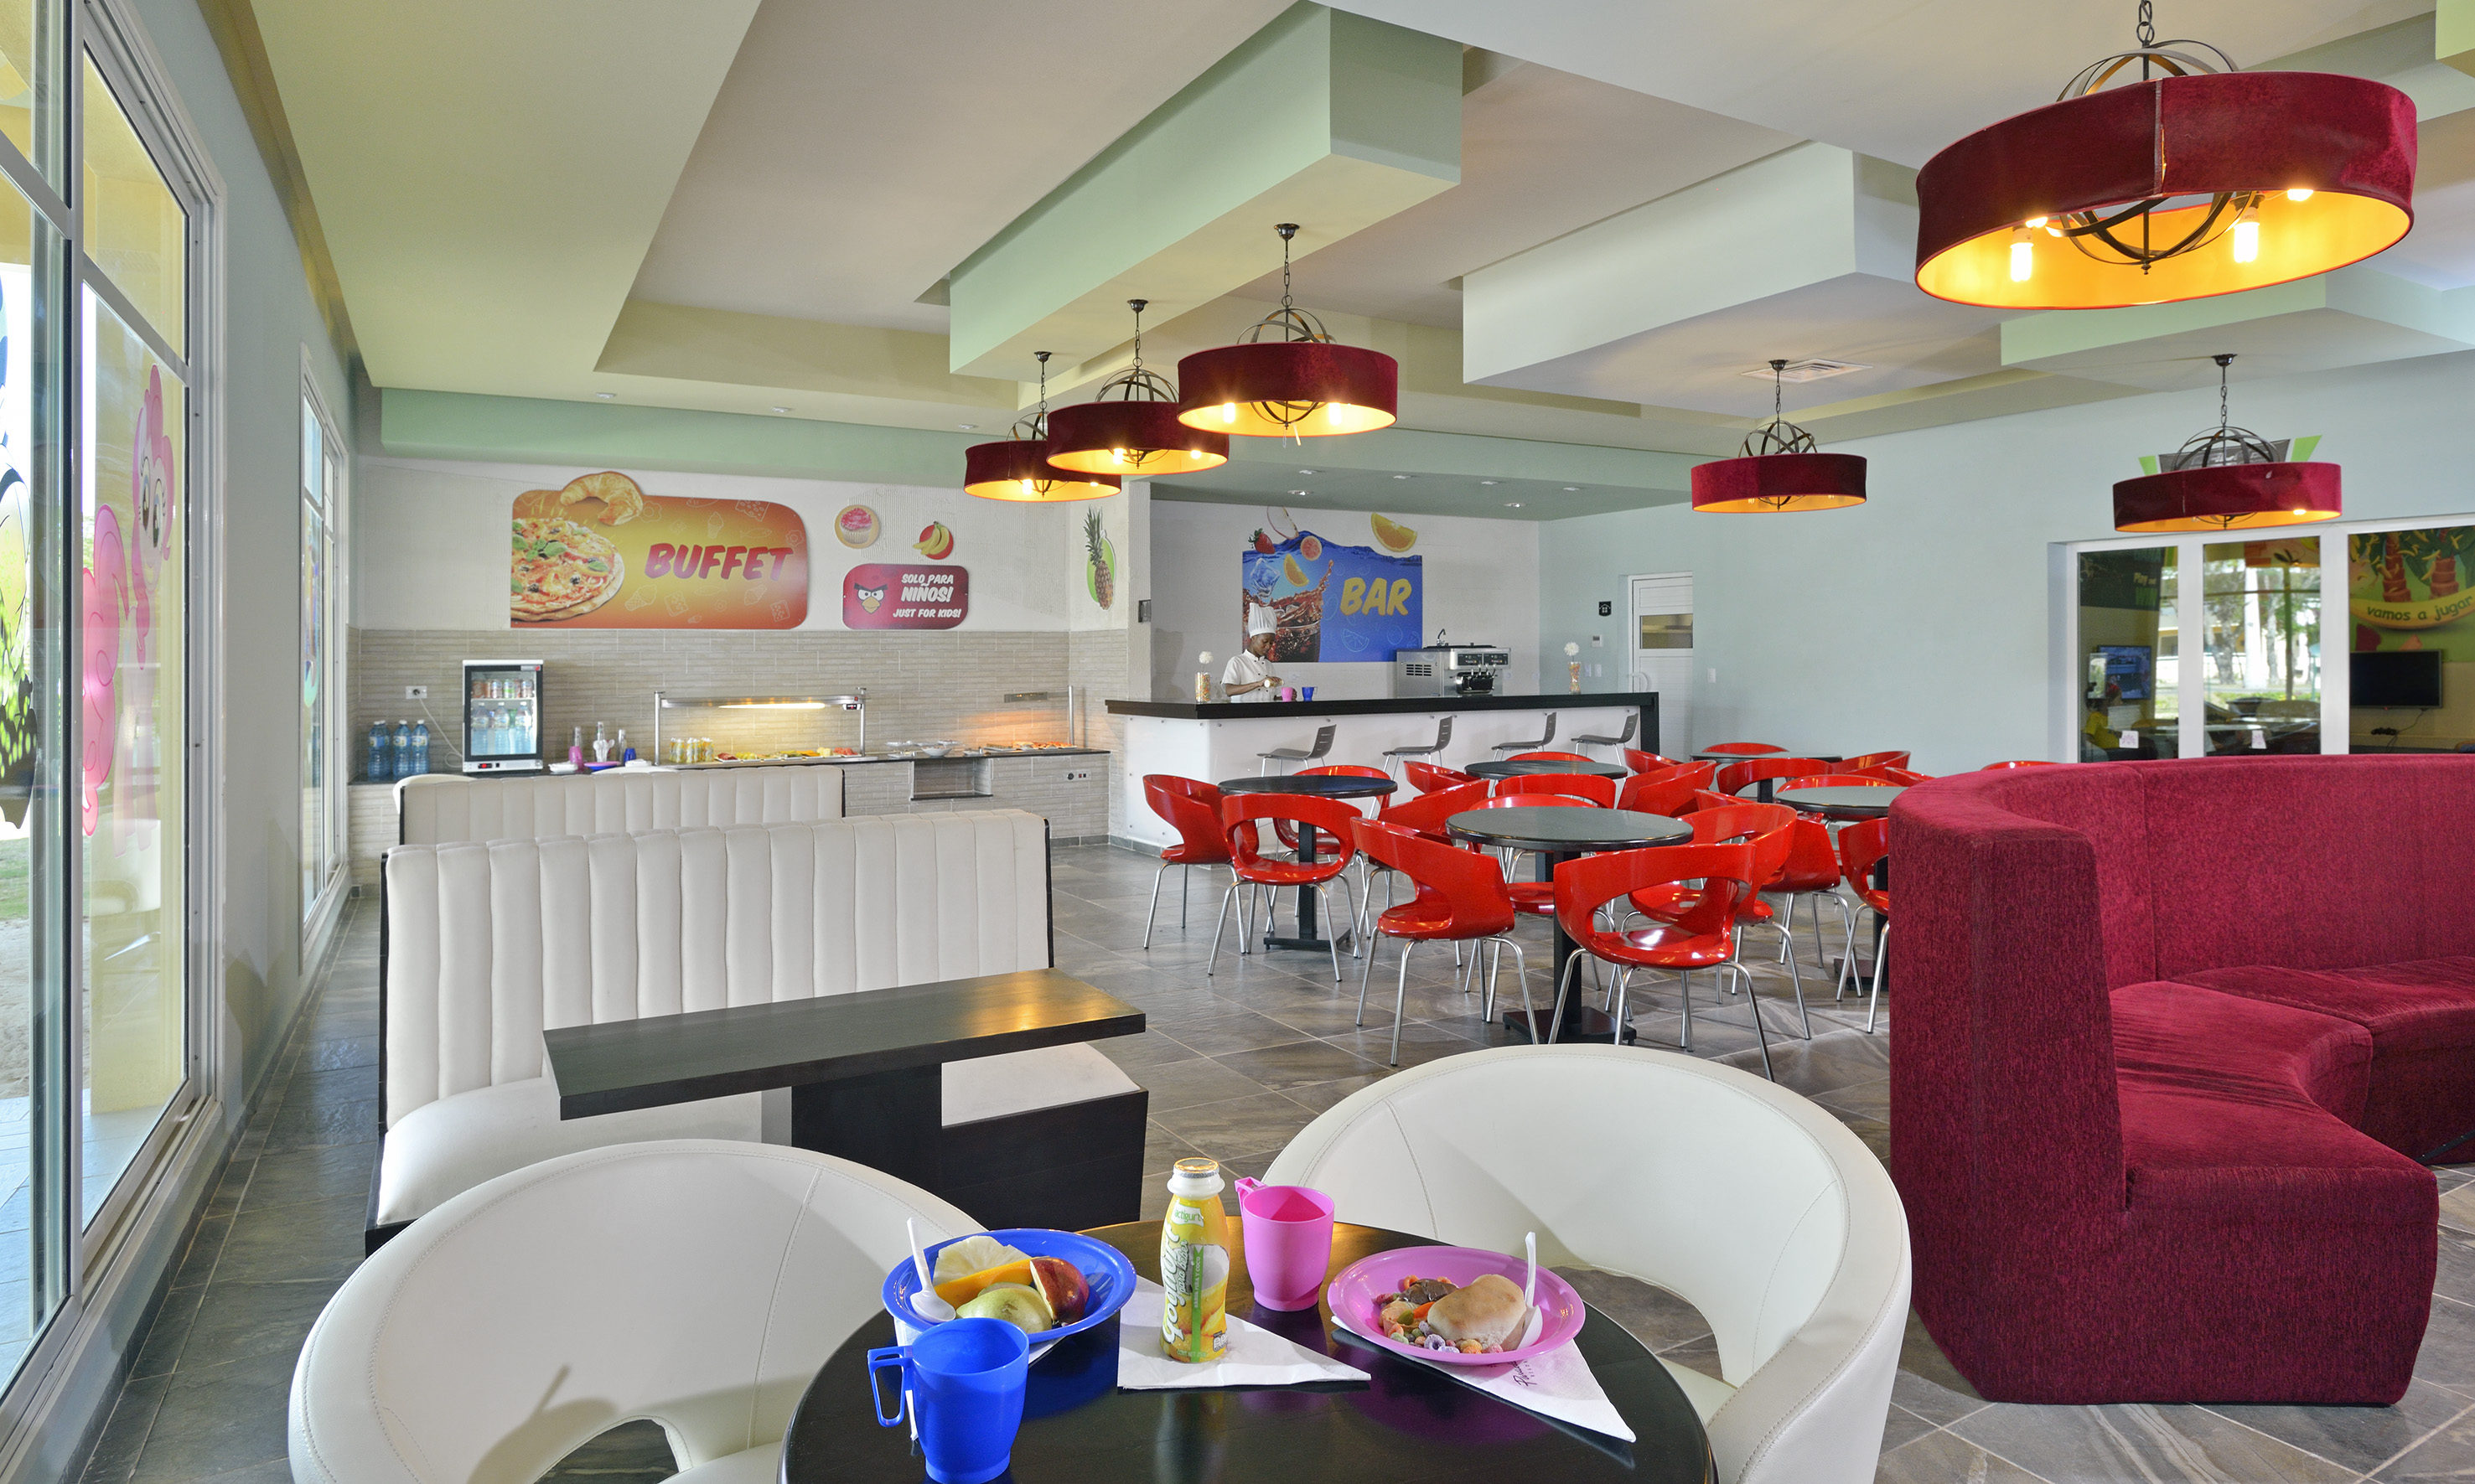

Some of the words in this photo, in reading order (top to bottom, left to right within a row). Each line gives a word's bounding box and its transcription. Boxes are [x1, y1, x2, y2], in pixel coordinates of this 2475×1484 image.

[645, 542, 794, 582] BUFFET
[900, 582, 955, 602] NIÑOS!
[901, 573, 926, 584] SOLO
[927, 574, 955, 585] PARA
[1339, 577, 1412, 616] BAR
[2367, 606, 2410, 621] vamos
[2417, 611, 2427, 620] a
[2434, 596, 2472, 621] jugar
[893, 608, 916, 618] JUST
[918, 608, 936, 618] FOR
[938, 608, 962, 618] KIDS!
[1179, 1239, 1189, 1271] beber
[1177, 1268, 1193, 1295] para
